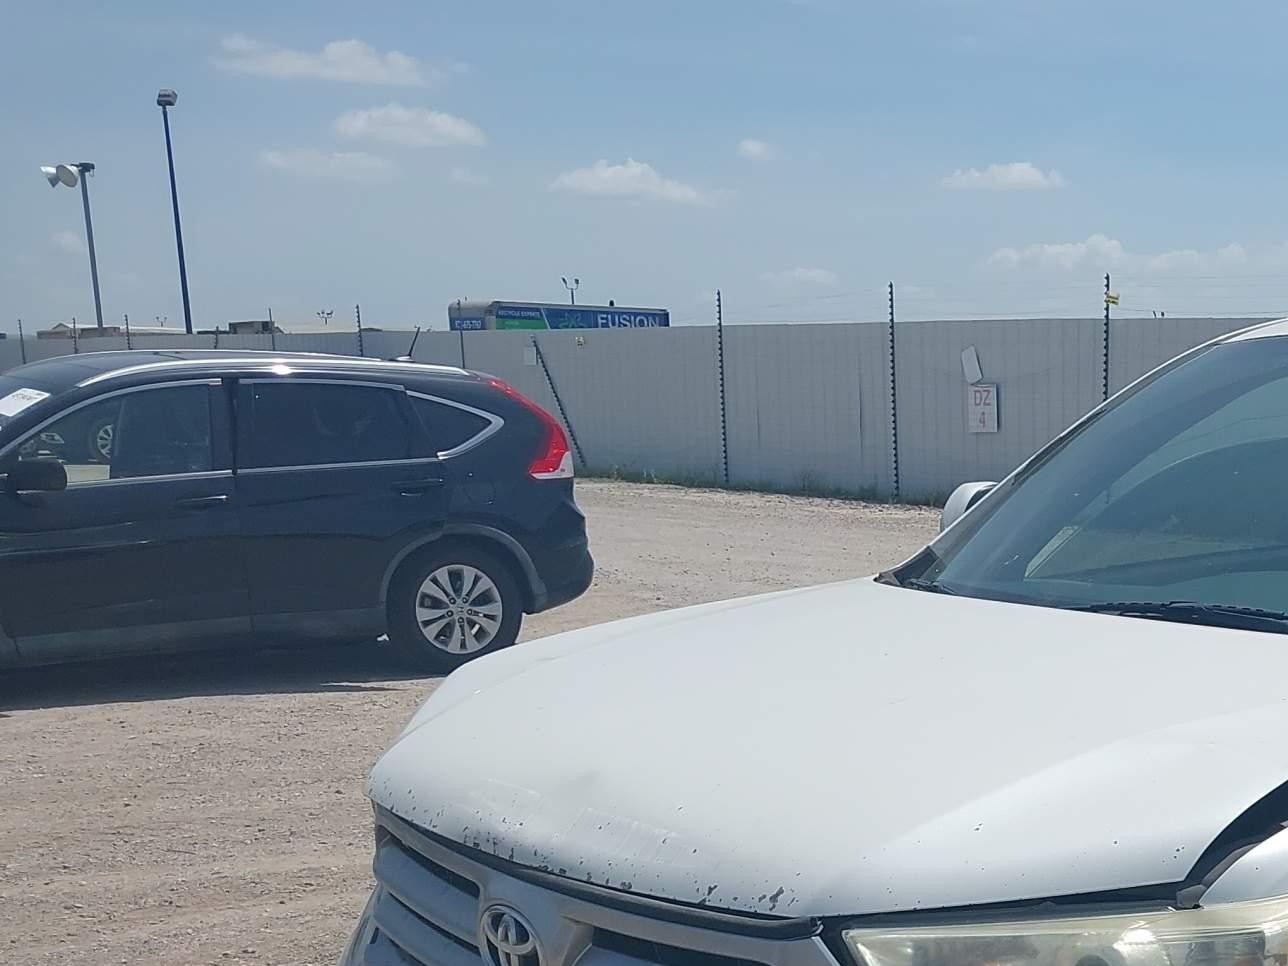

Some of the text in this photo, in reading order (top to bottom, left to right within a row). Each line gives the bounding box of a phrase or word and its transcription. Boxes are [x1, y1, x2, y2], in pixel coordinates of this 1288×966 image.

[598, 313, 660, 328] FUSION
[974, 389, 992, 406] DZ
[979, 411, 986, 429] 4
